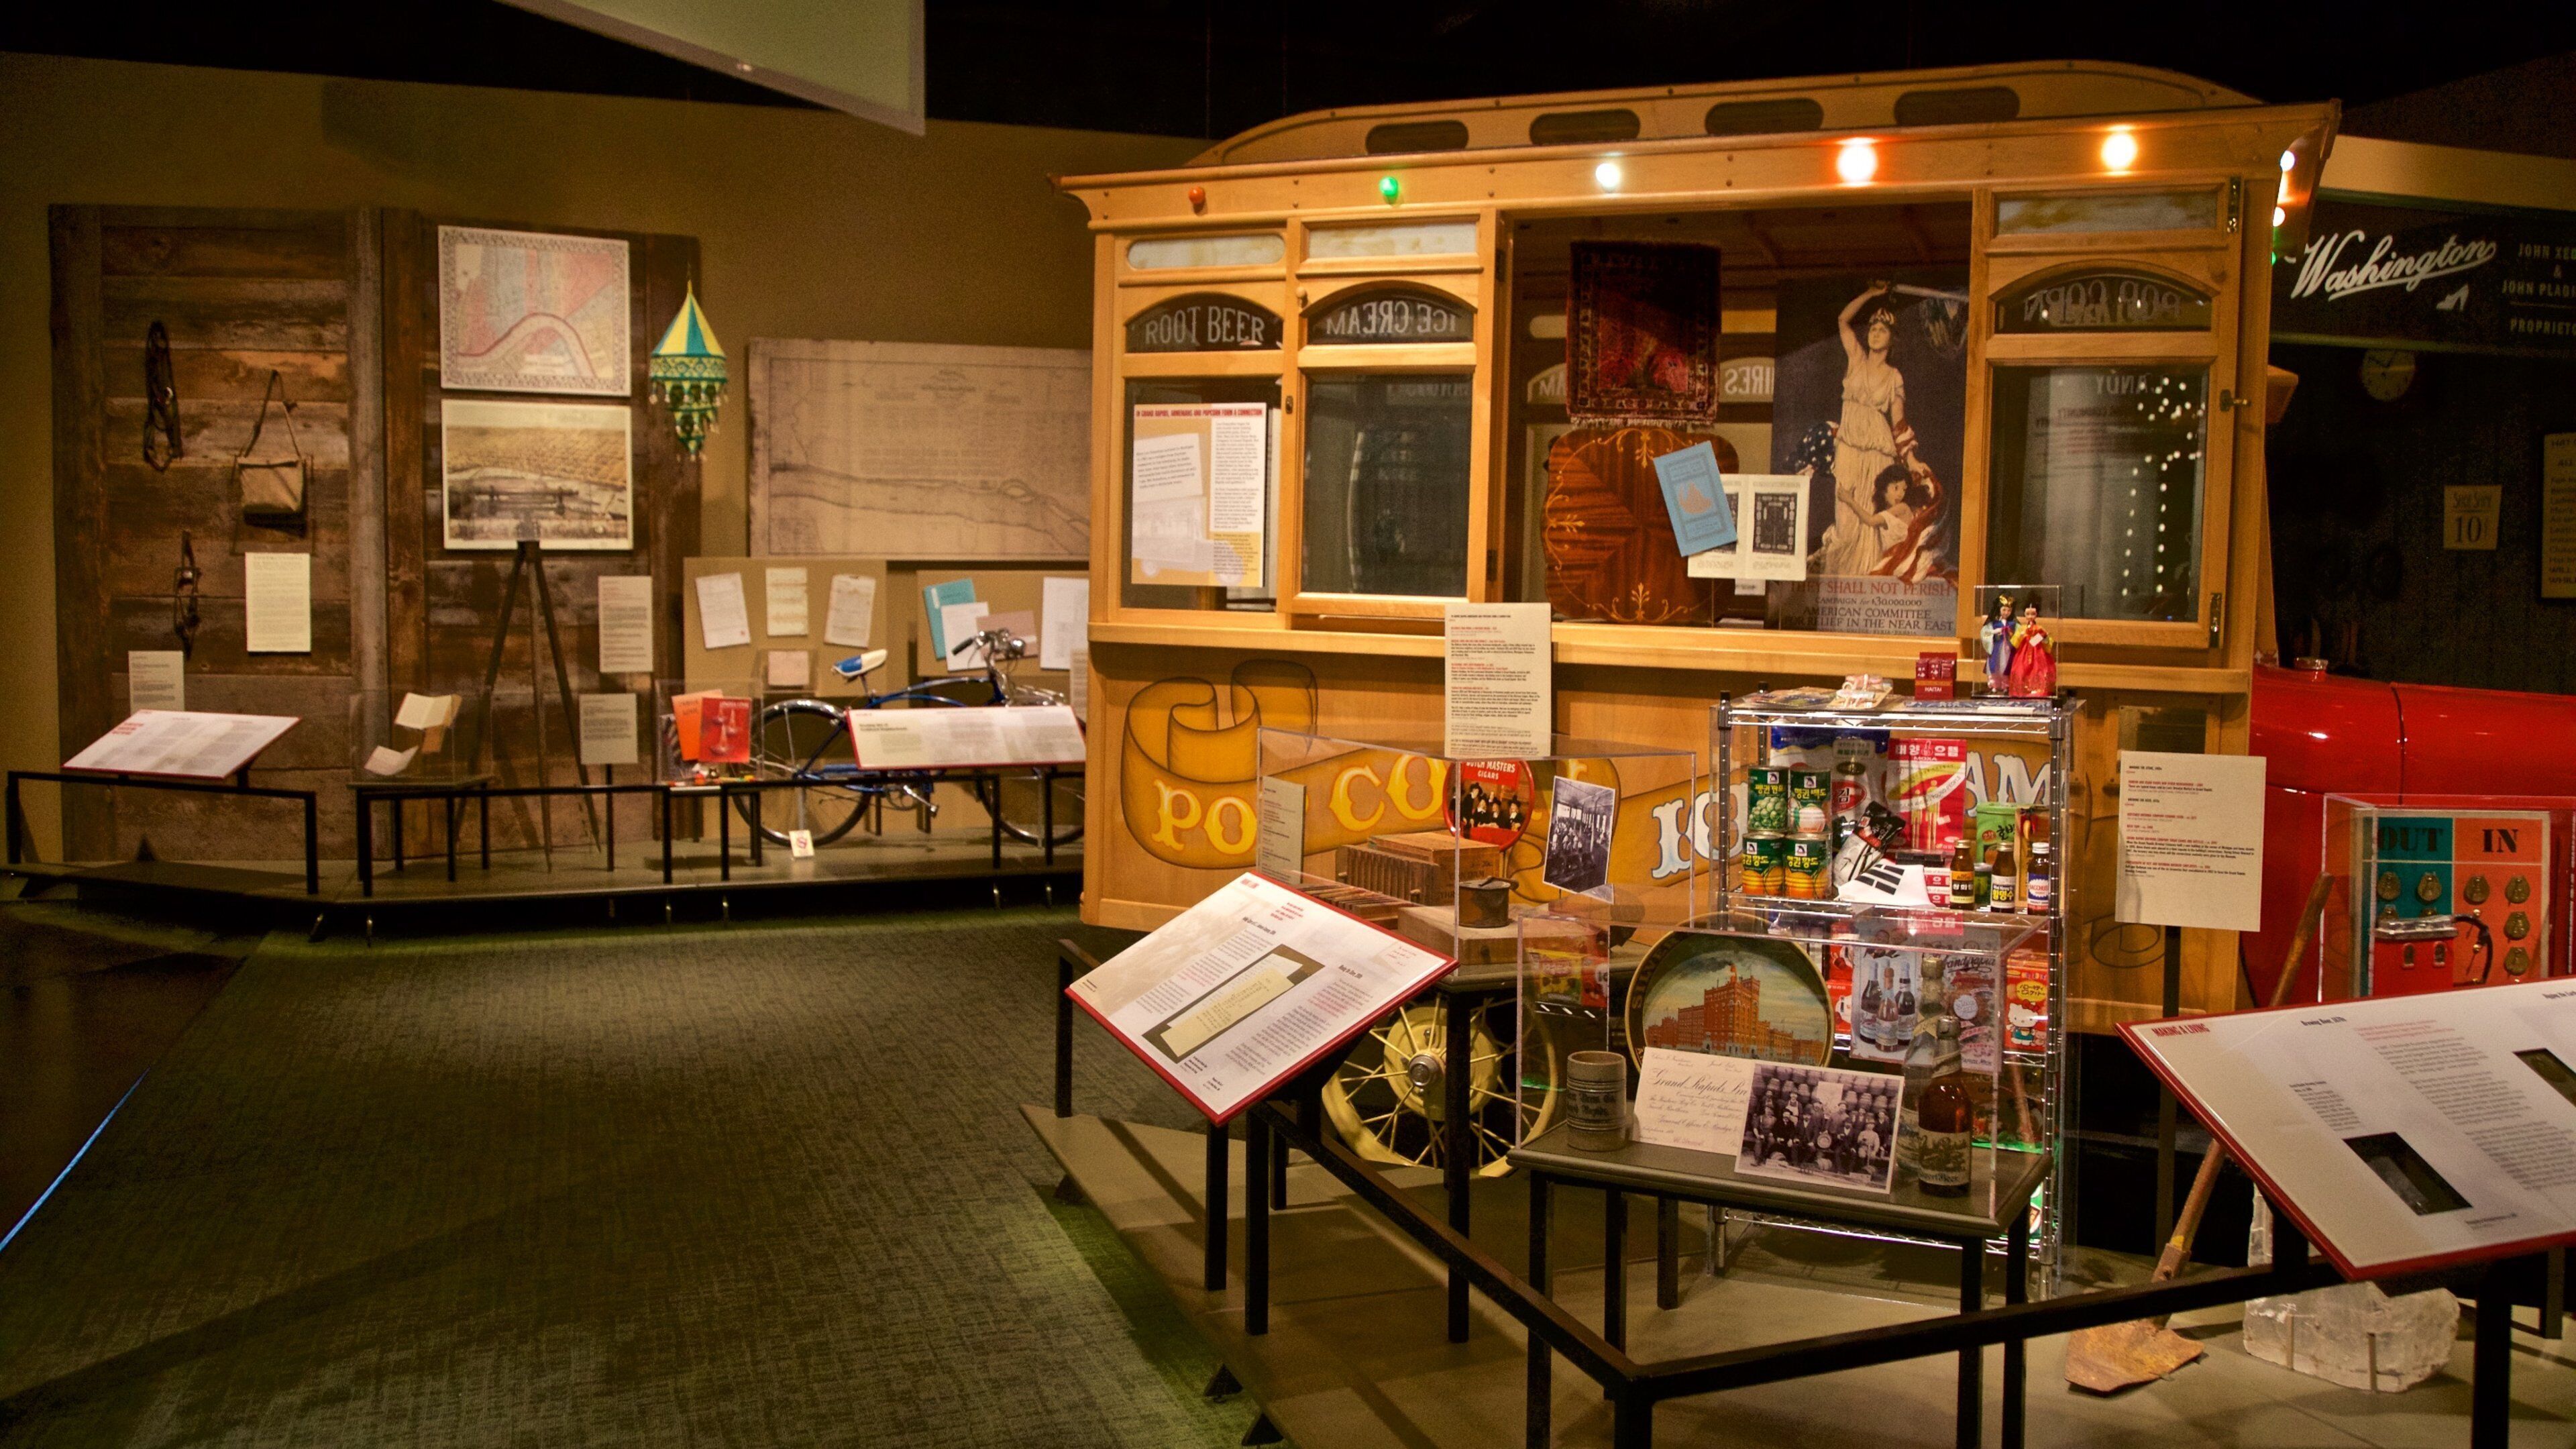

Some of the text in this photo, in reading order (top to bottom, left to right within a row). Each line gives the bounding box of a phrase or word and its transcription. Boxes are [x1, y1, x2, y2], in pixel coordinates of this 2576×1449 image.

[2518, 242, 2550, 260] JOHN
[2286, 229, 2498, 301] Washington
[2502, 280, 2534, 295] JOHN
[1145, 305, 1265, 345] ROOT BEER
[1790, 581, 1951, 597] THEY SHALL NOT PERISH
[1815, 596, 1858, 605] CAMPAIGN
[1803, 606, 1932, 619] AMERICAN COMMITTEE
[1808, 616, 1844, 627] RELIEF
[1846, 617, 1862, 627] IN
[1863, 618, 1885, 628] THE
[1888, 619, 1921, 630] NEAR
[1924, 620, 1954, 631] EAST
[1487, 761, 1516, 773] MASTERS
[1477, 770, 1499, 780] CIGARS
[2375, 826, 2519, 853] OUT IN
[2151, 1026, 2182, 1037] MAKING
[2188, 1023, 2210, 1034] LIVING
[1647, 1068, 1691, 1087] Grand
[1692, 1075, 1728, 1095] Rapids
